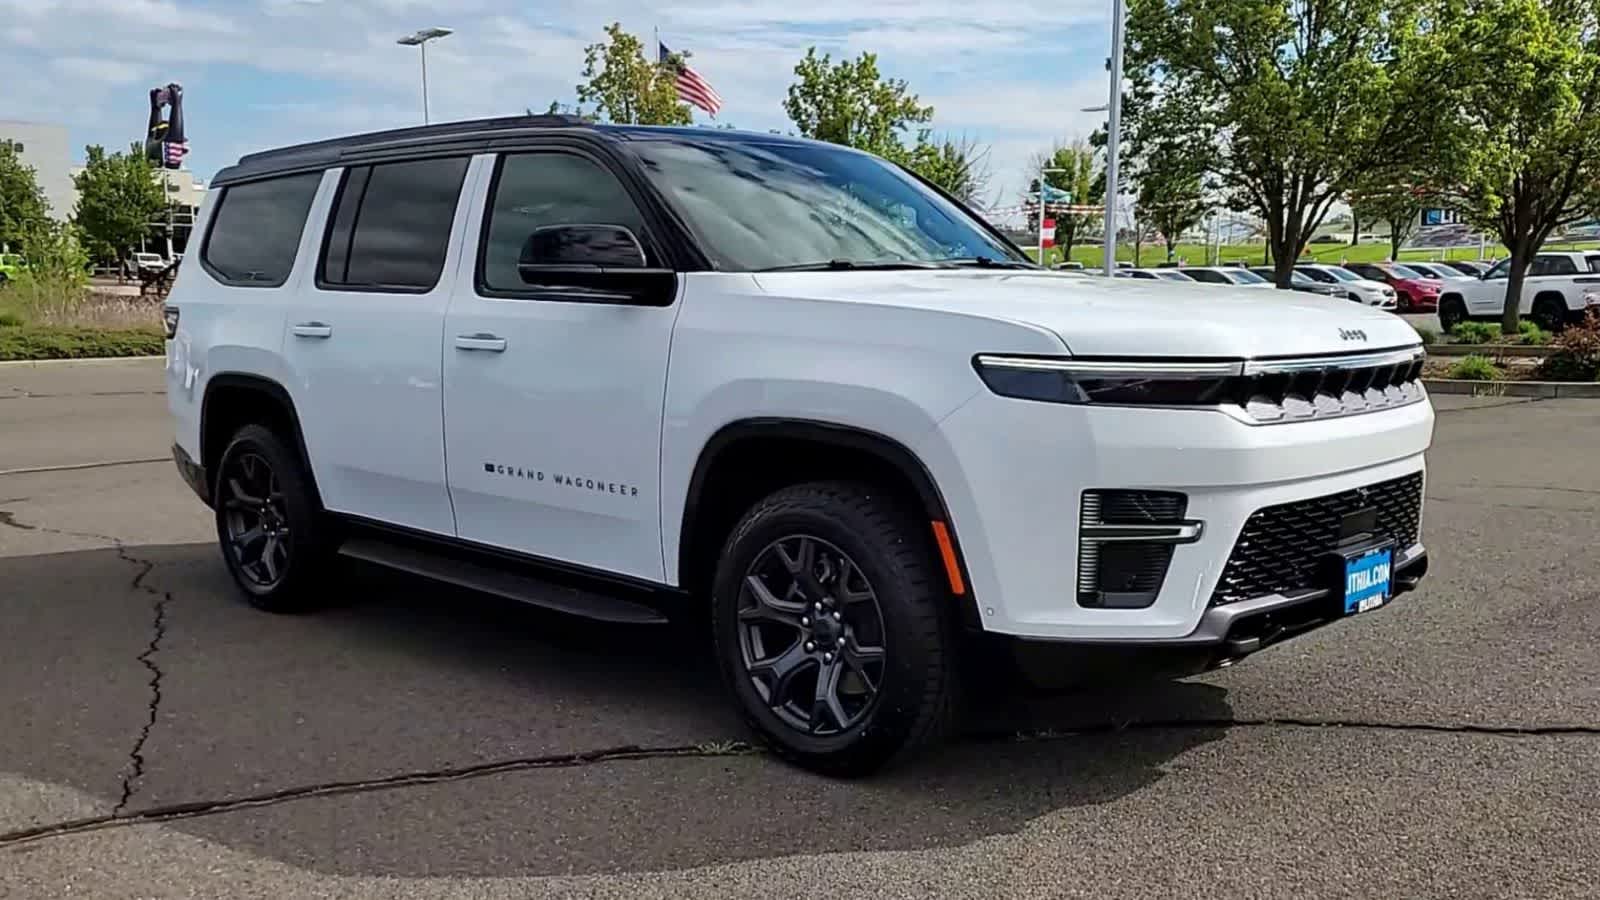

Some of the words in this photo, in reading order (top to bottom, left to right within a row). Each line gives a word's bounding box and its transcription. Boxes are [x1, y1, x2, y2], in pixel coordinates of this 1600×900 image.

[1338, 327, 1367, 342] Jeep
[497, 464, 545, 482] GRAND
[553, 474, 638, 497] WAGONEER
[1345, 562, 1391, 596] ITHIA.COM
